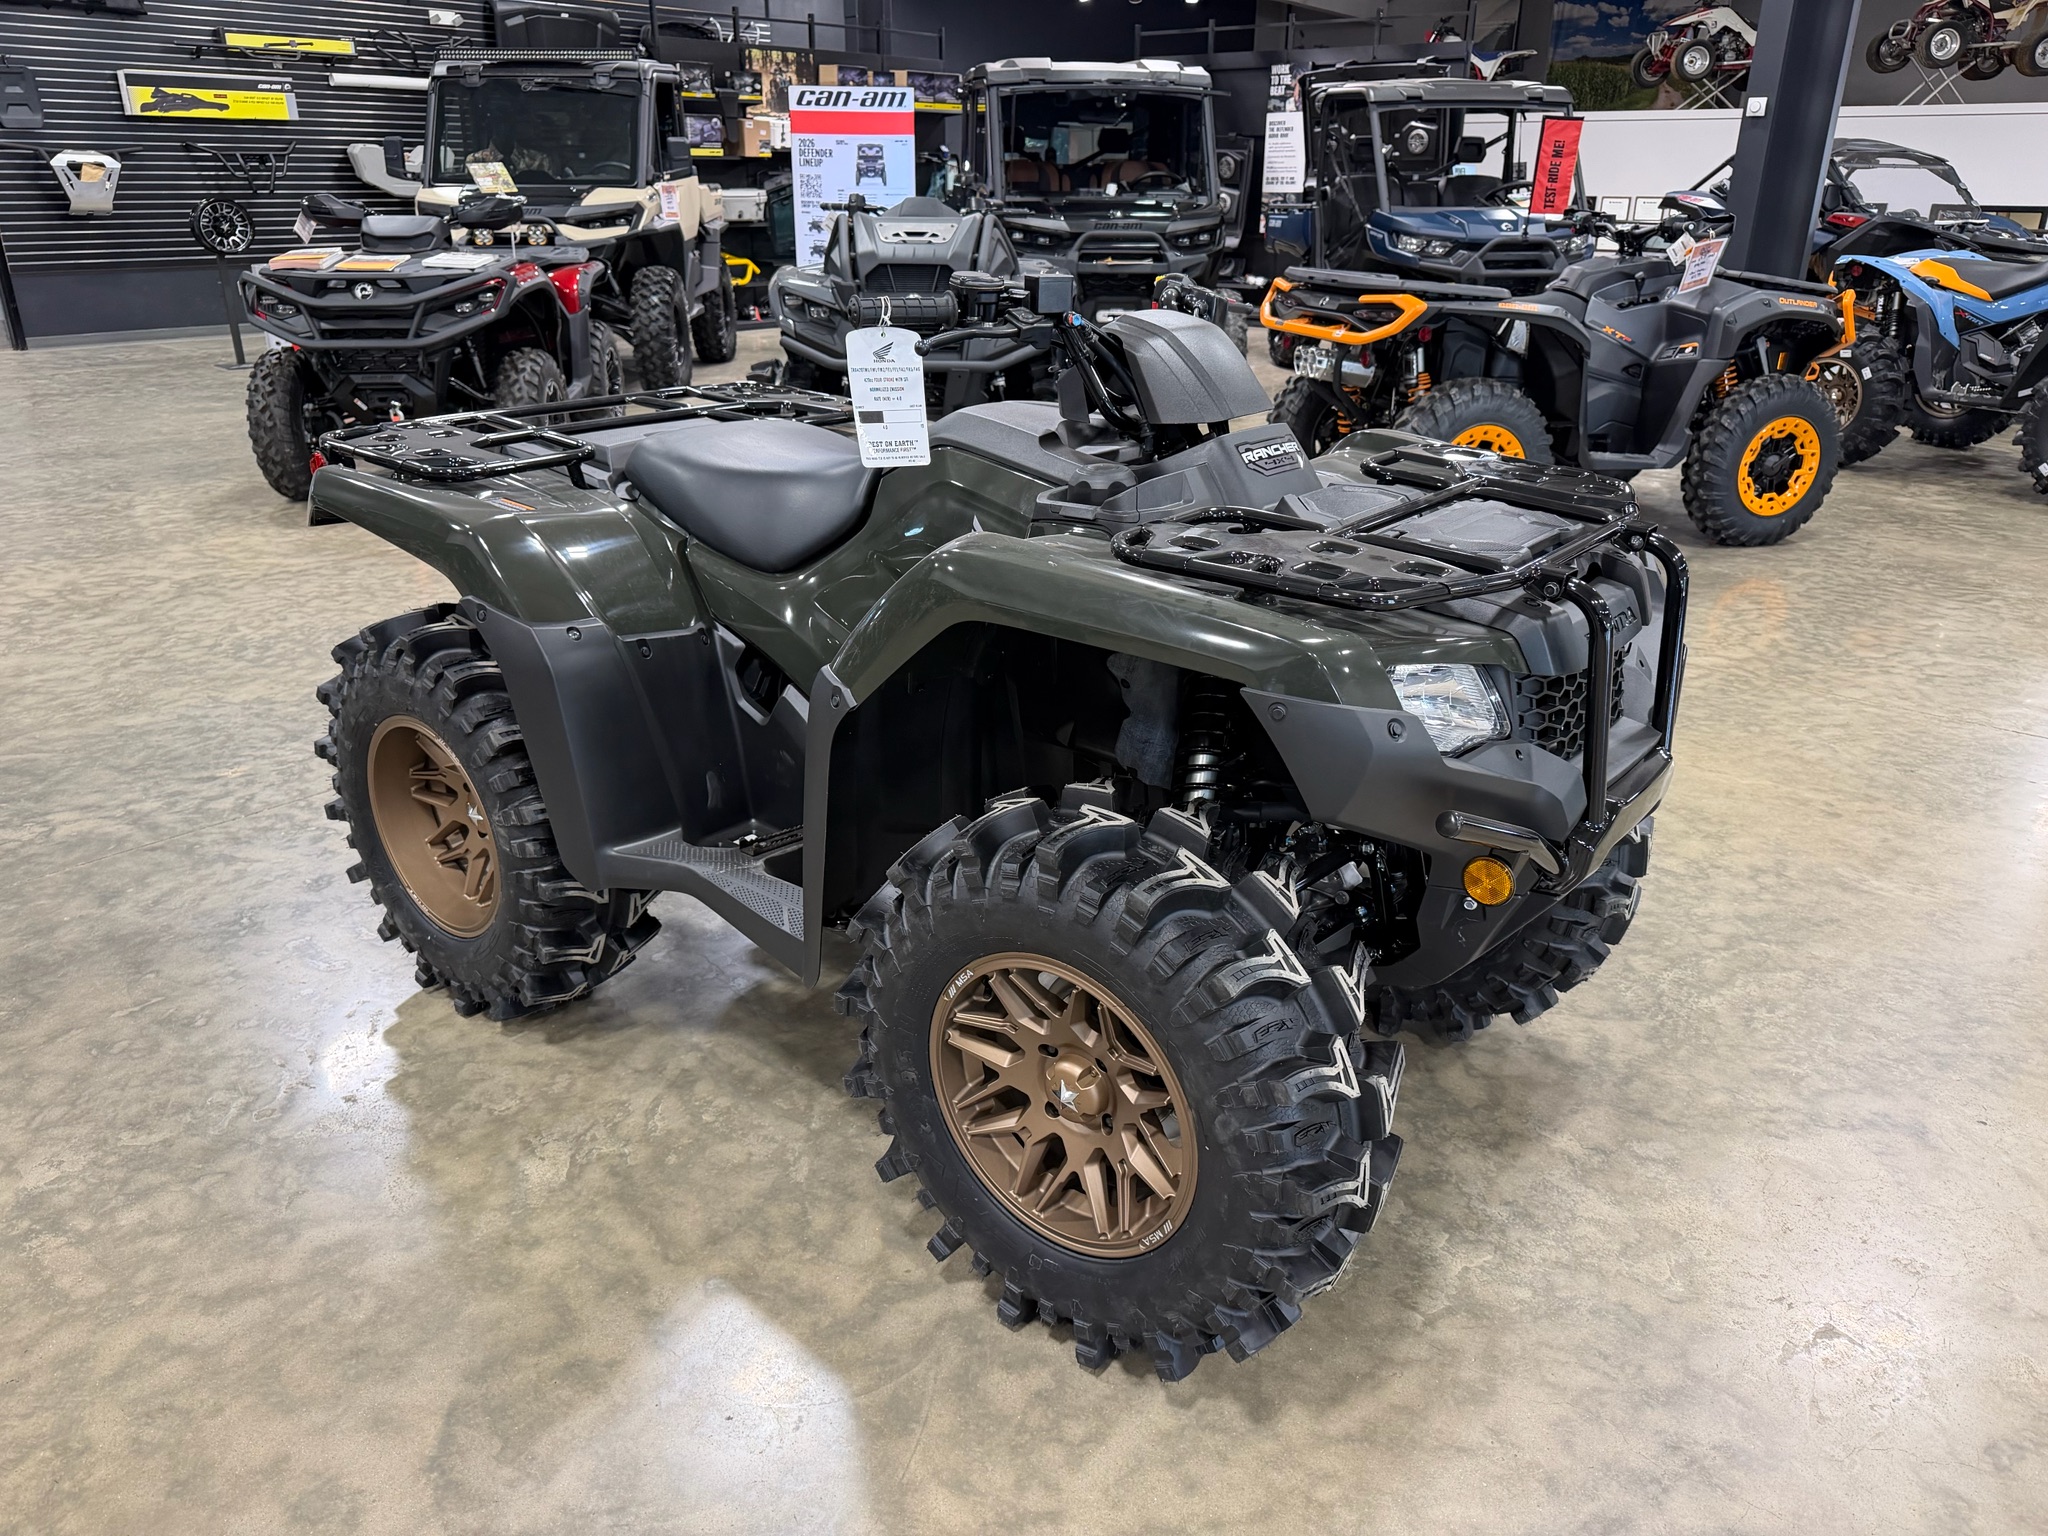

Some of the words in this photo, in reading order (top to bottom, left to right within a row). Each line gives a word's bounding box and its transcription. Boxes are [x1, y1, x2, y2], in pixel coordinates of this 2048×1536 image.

[1271, 75, 1279, 85] TO
[798, 138, 816, 148] 2026
[1551, 139, 1566, 158] ME!
[798, 148, 834, 158] DEFENDER
[799, 158, 823, 167] LINEUP
[1543, 161, 1562, 209] TEST-RIDE
[1779, 297, 1818, 308] OUTLANDER
[1241, 442, 1300, 464] RANCHER
[955, 969, 974, 988] MSA
[1141, 1229, 1164, 1246] MSA
